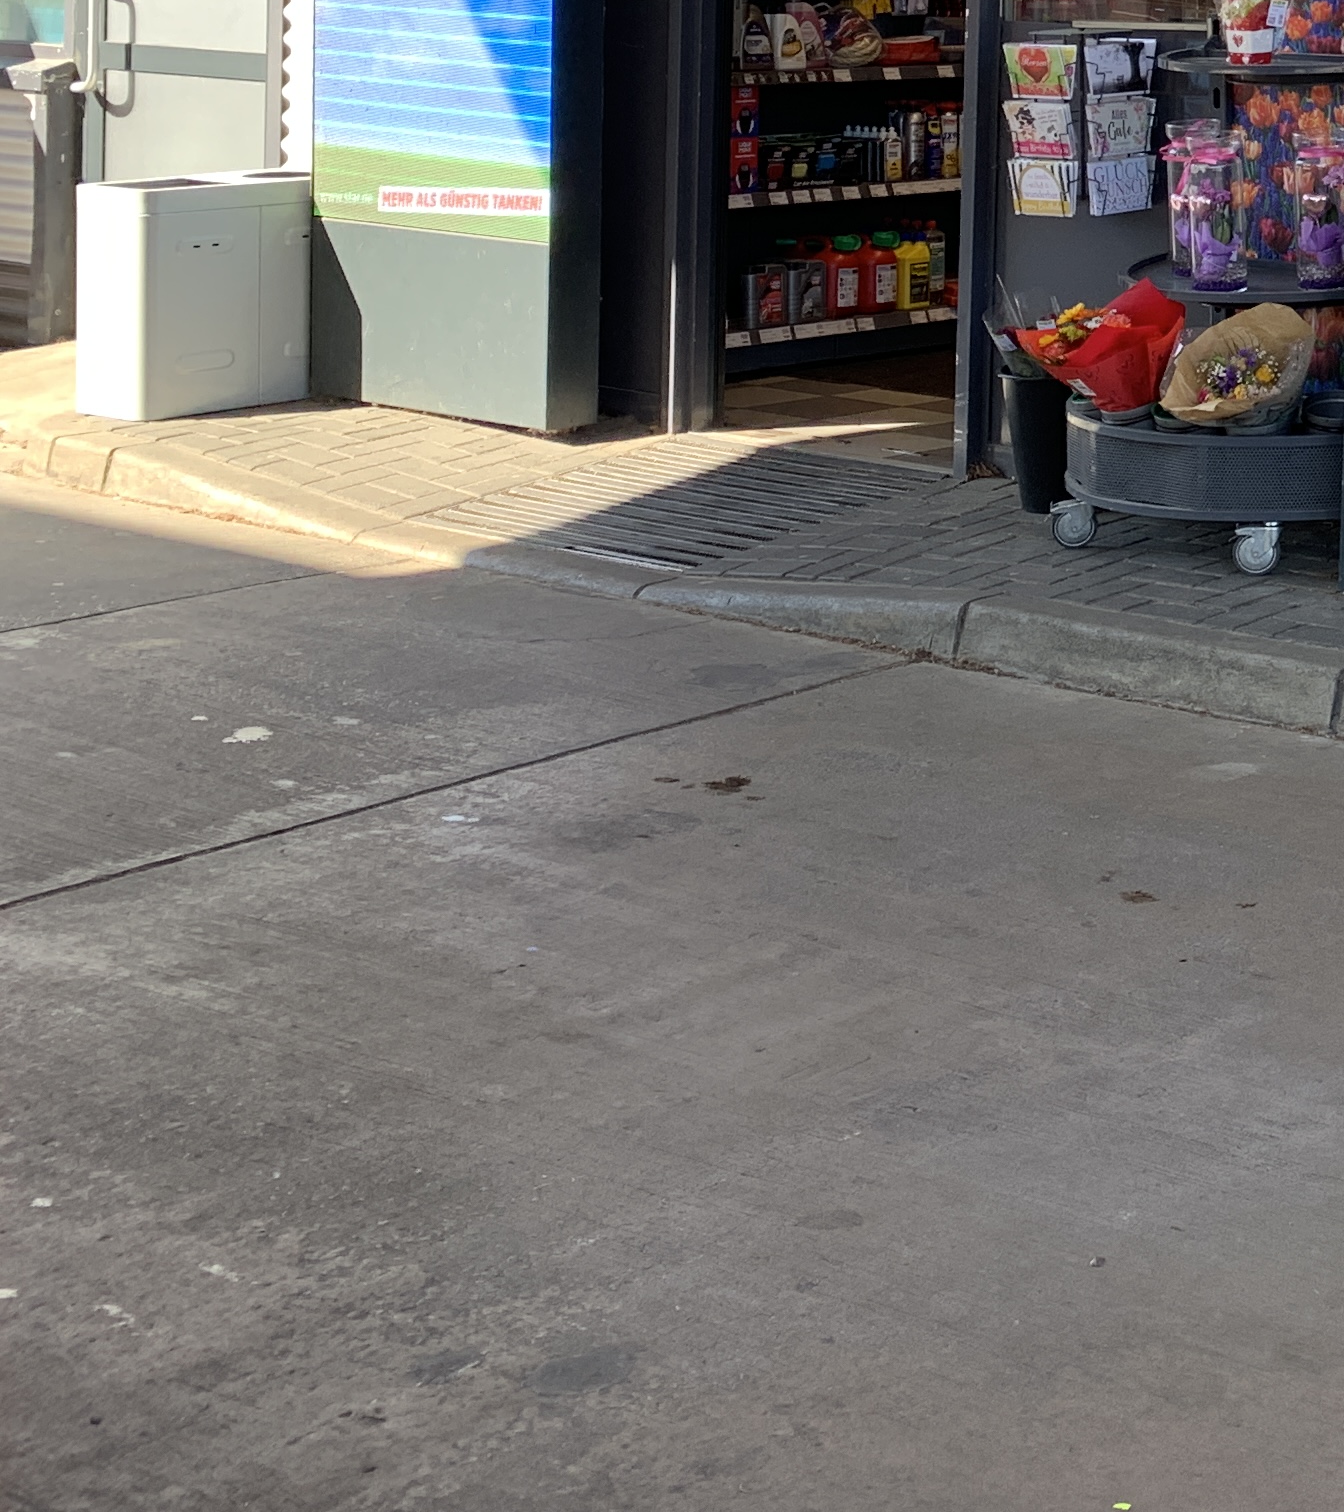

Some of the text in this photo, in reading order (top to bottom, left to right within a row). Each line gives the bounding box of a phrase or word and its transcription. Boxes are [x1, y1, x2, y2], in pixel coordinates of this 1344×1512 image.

[381, 190, 543, 212] MEHR ALS GÜNSTIG TANKEN!
